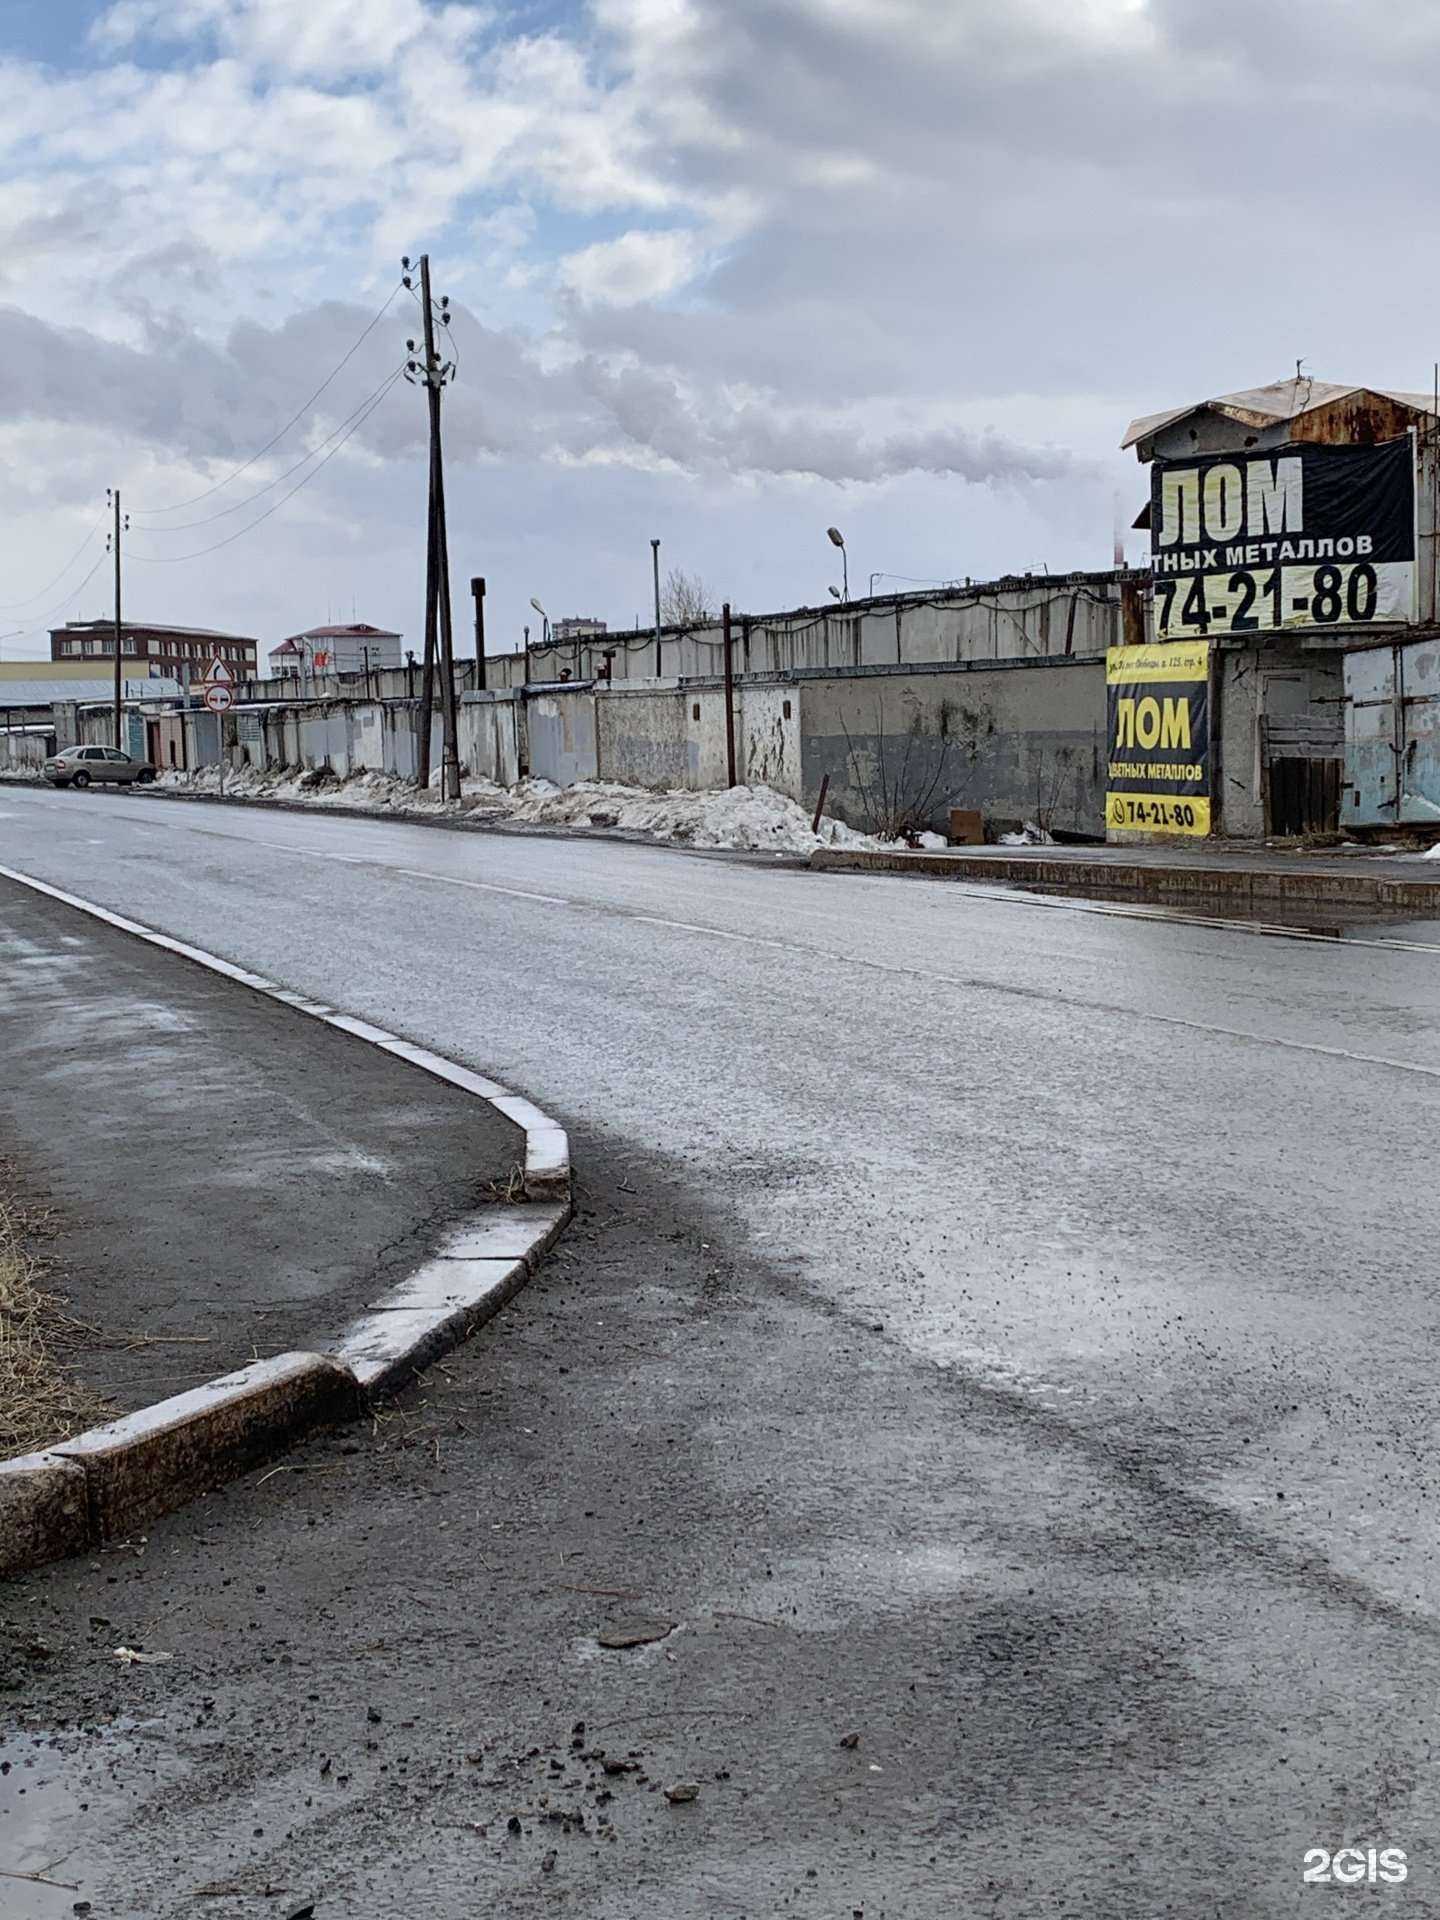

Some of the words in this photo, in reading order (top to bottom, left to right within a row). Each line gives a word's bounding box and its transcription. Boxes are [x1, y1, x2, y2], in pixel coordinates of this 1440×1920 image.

[1159, 456, 1304, 547] ЛОМ
[1226, 534, 1374, 568] МЕТАЛЛОВ
[1154, 563, 1378, 635] 74-21-80
[1116, 696, 1191, 749] ЛОМ
[1147, 763, 1203, 781] МЕТАЛЛОВ
[1127, 801, 1195, 828] 74-21-80
